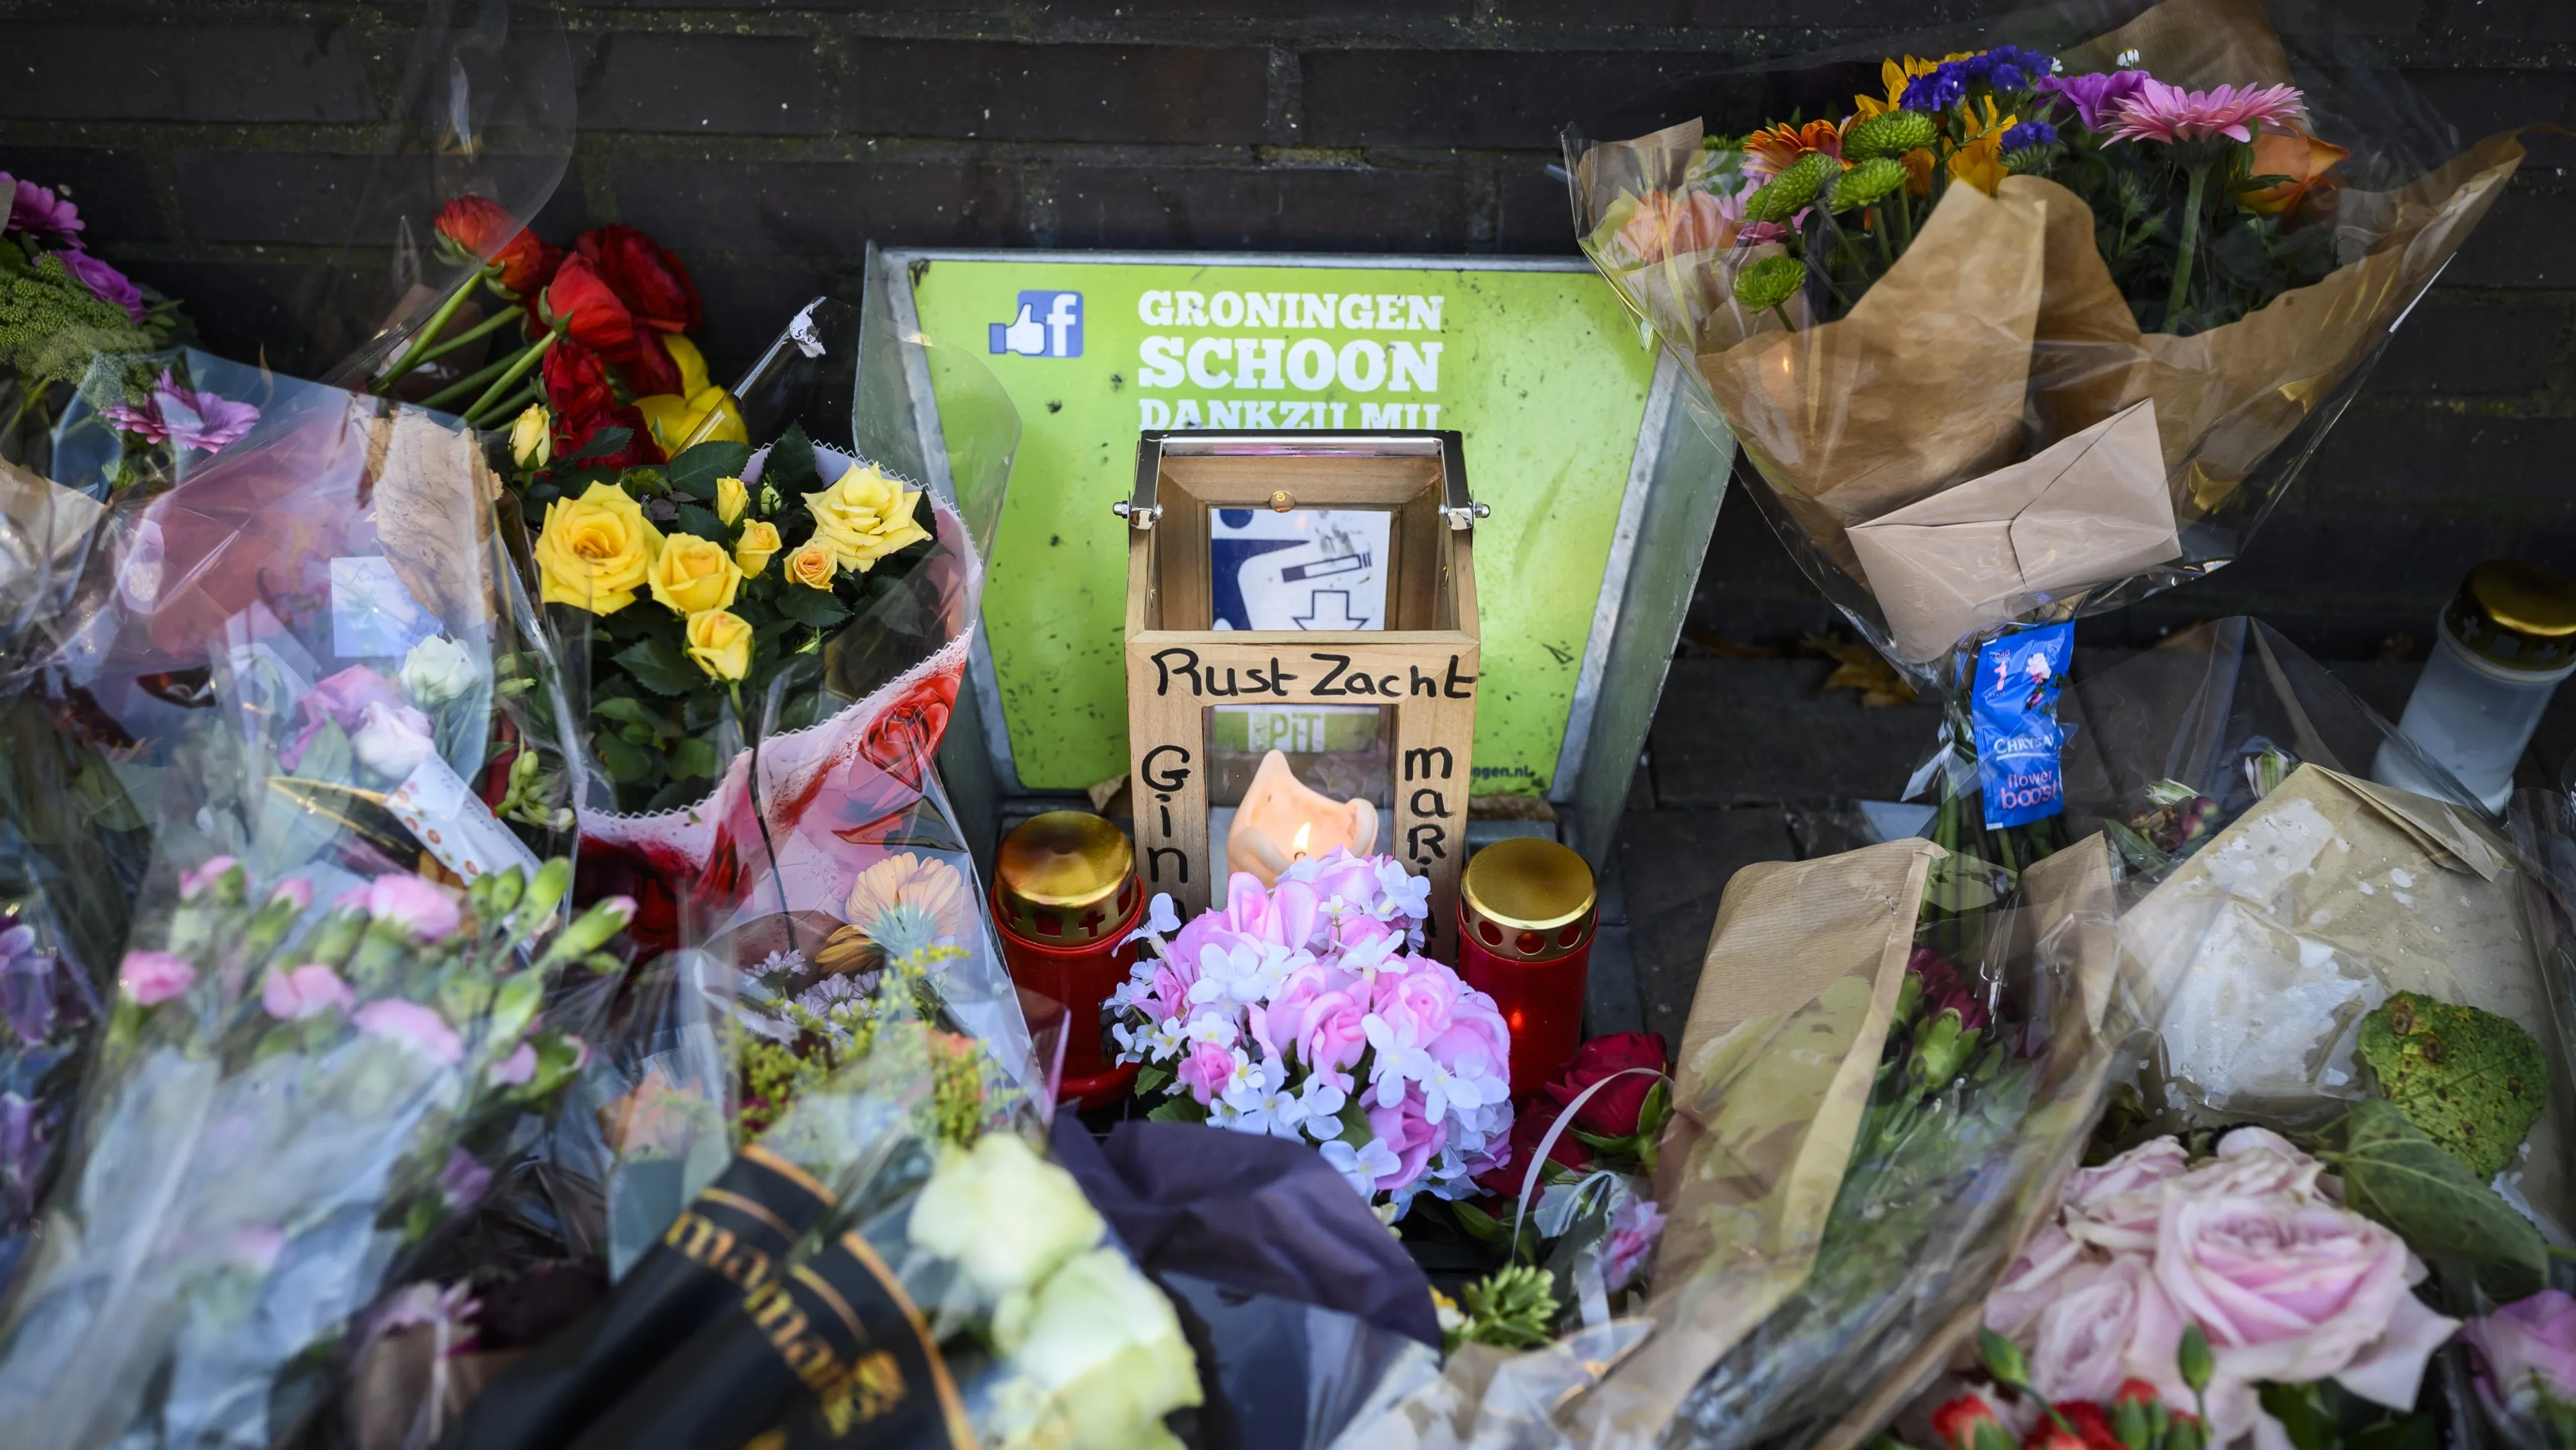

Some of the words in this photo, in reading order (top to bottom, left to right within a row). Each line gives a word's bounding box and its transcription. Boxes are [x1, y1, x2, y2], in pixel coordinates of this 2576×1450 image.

[1138, 290, 1444, 330] GRONINGEN
[1138, 335, 1444, 393] SCHOON
[1150, 648, 1299, 696] Rust
[1310, 653, 1477, 698] Zacht
[1994, 660, 2007, 691] 1
[1471, 764, 1530, 780] ngen.nl
[2007, 770, 2053, 788] flower
[2000, 779, 2057, 809] boost
